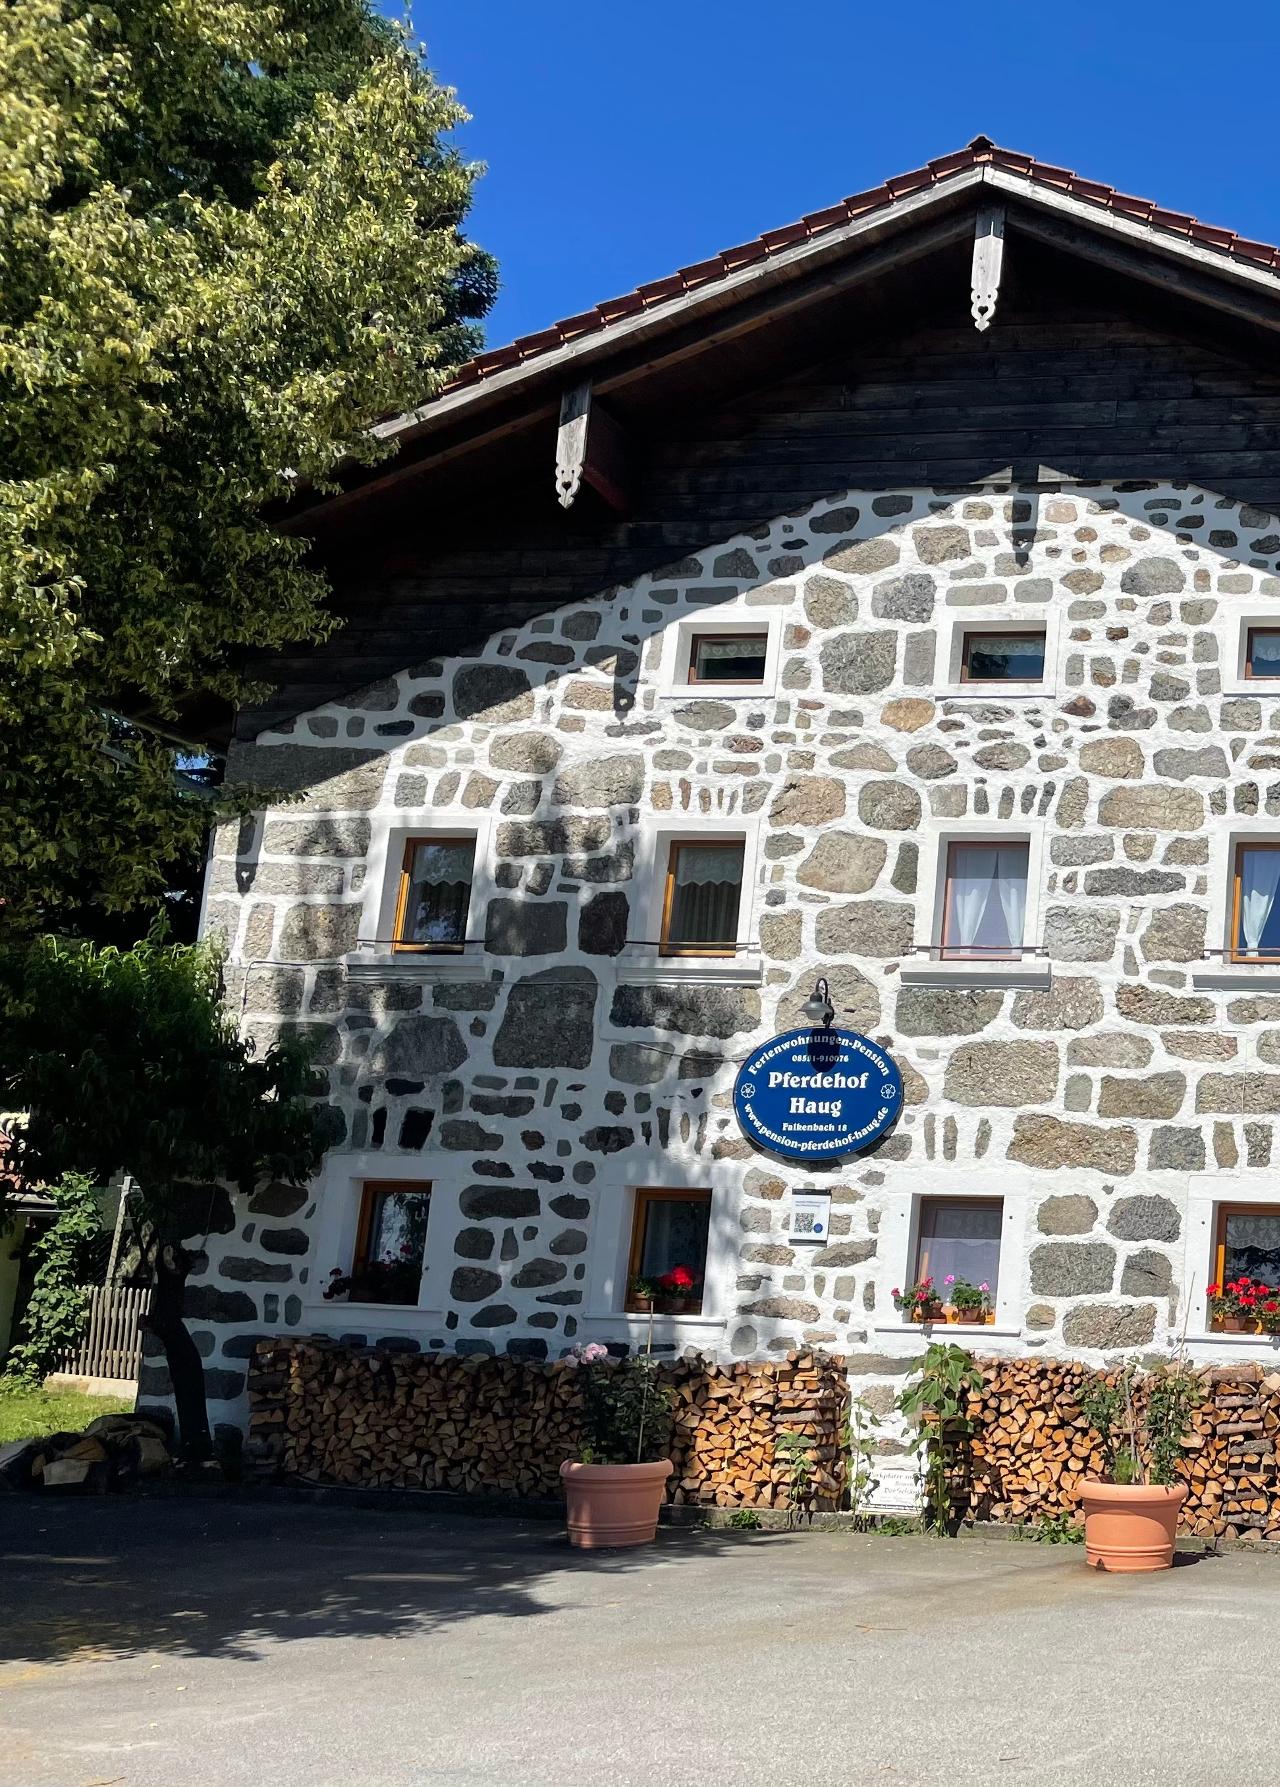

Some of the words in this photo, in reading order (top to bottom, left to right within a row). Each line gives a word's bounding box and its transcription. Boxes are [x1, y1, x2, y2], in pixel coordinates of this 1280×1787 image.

[747, 1035, 890, 1077] Ferienwohnungen-Pension
[768, 1071, 870, 1089] Pferdehof
[789, 1097, 842, 1118] Haug
[744, 1102, 889, 1152] www.pension-pferdehof-haug.de
[782, 1122, 835, 1132] Falkenbach
[837, 1123, 848, 1132] 18
